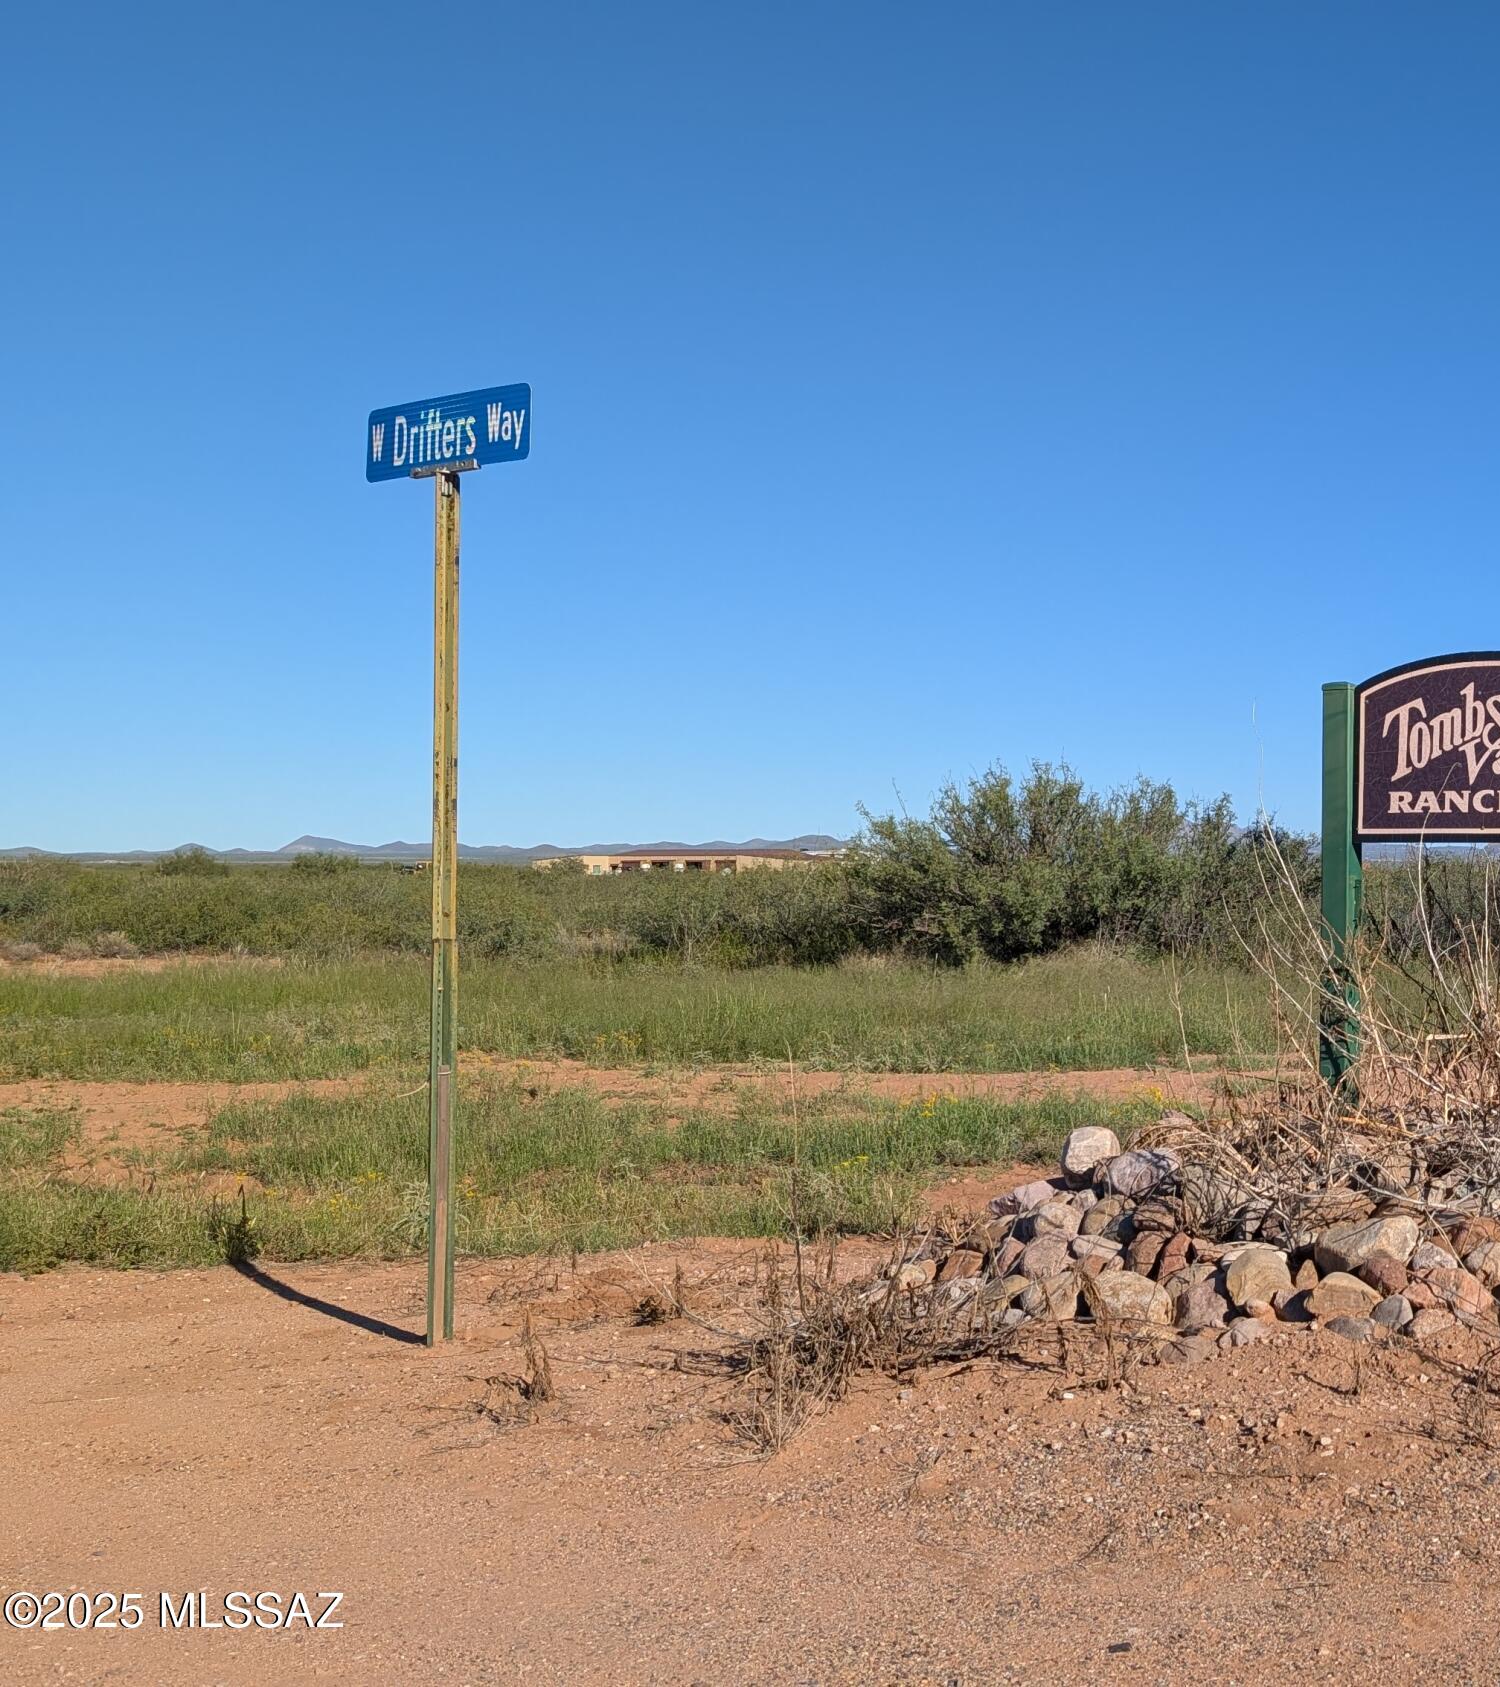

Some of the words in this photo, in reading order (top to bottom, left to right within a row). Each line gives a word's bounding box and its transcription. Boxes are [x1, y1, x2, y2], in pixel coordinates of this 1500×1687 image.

[372, 423, 385, 462] W
[393, 408, 476, 466] Drifters
[487, 402, 525, 450] Way
